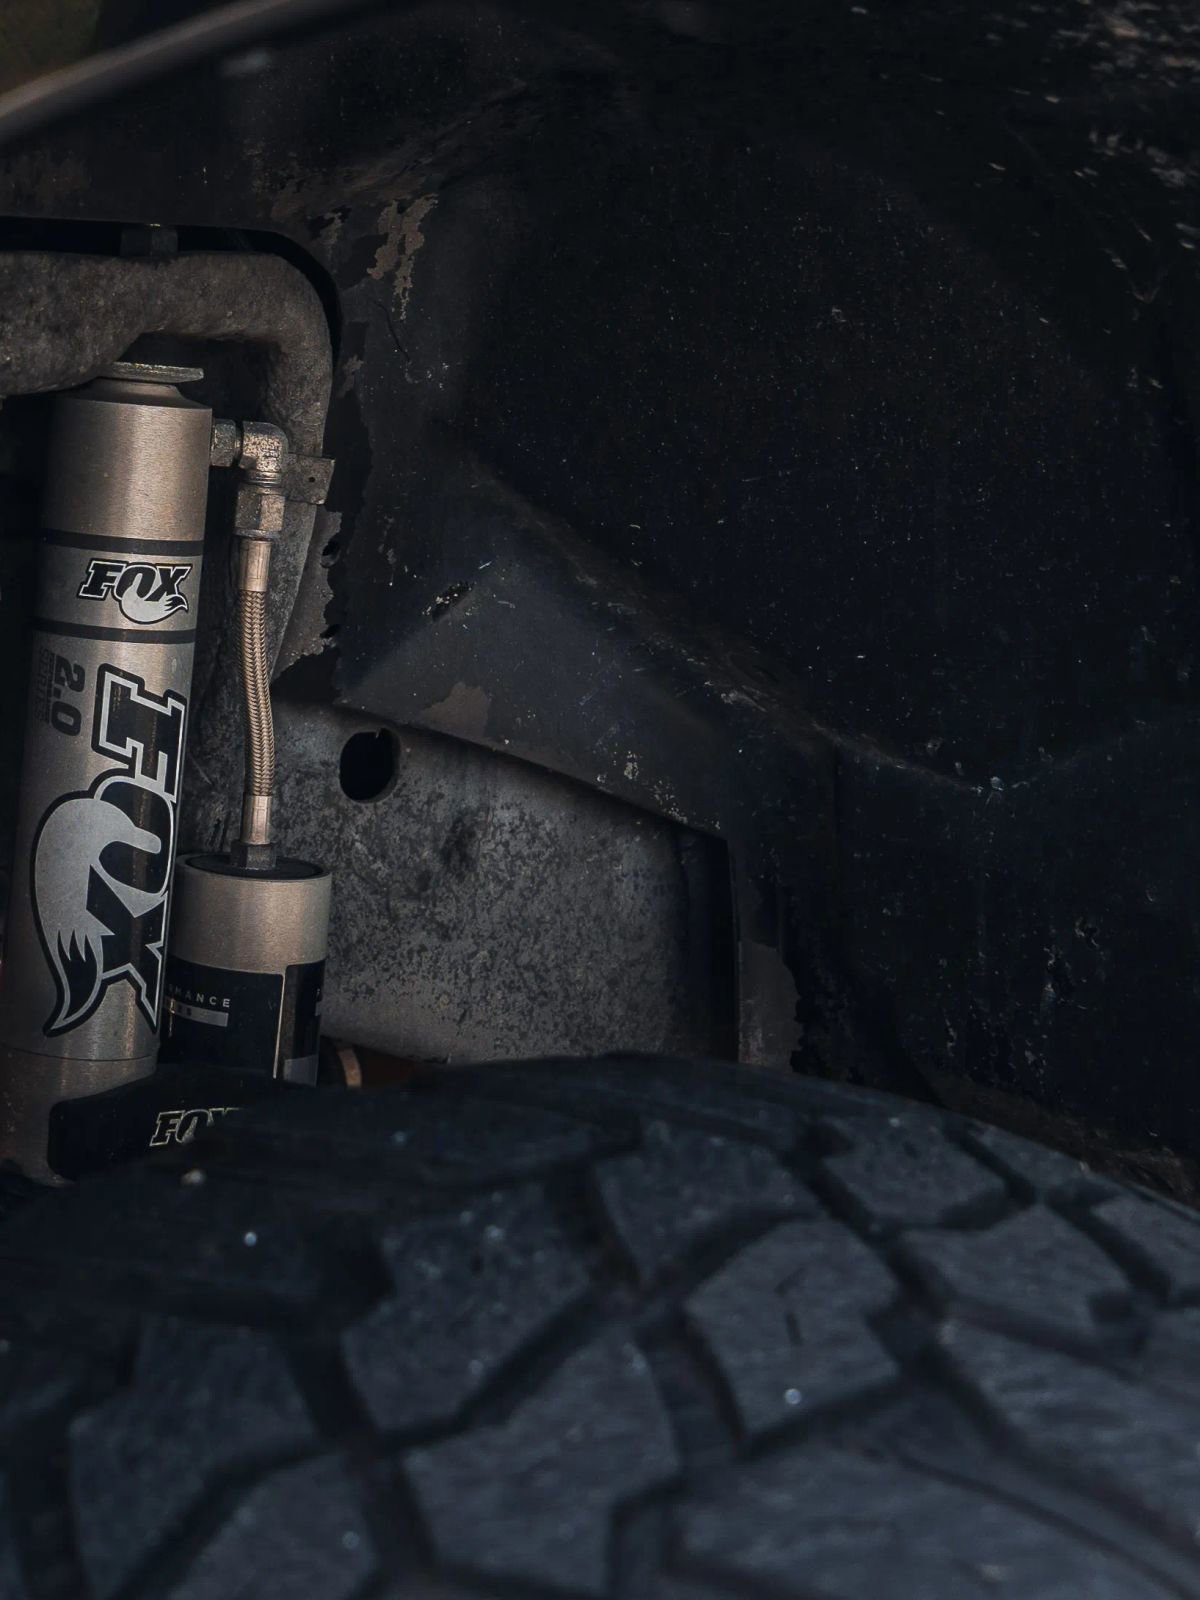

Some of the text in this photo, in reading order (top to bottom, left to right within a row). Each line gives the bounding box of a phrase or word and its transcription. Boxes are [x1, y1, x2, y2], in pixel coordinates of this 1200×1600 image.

[77, 558, 193, 624] FOX
[51, 653, 86, 737] 2.0
[29, 664, 189, 1038] FOX
